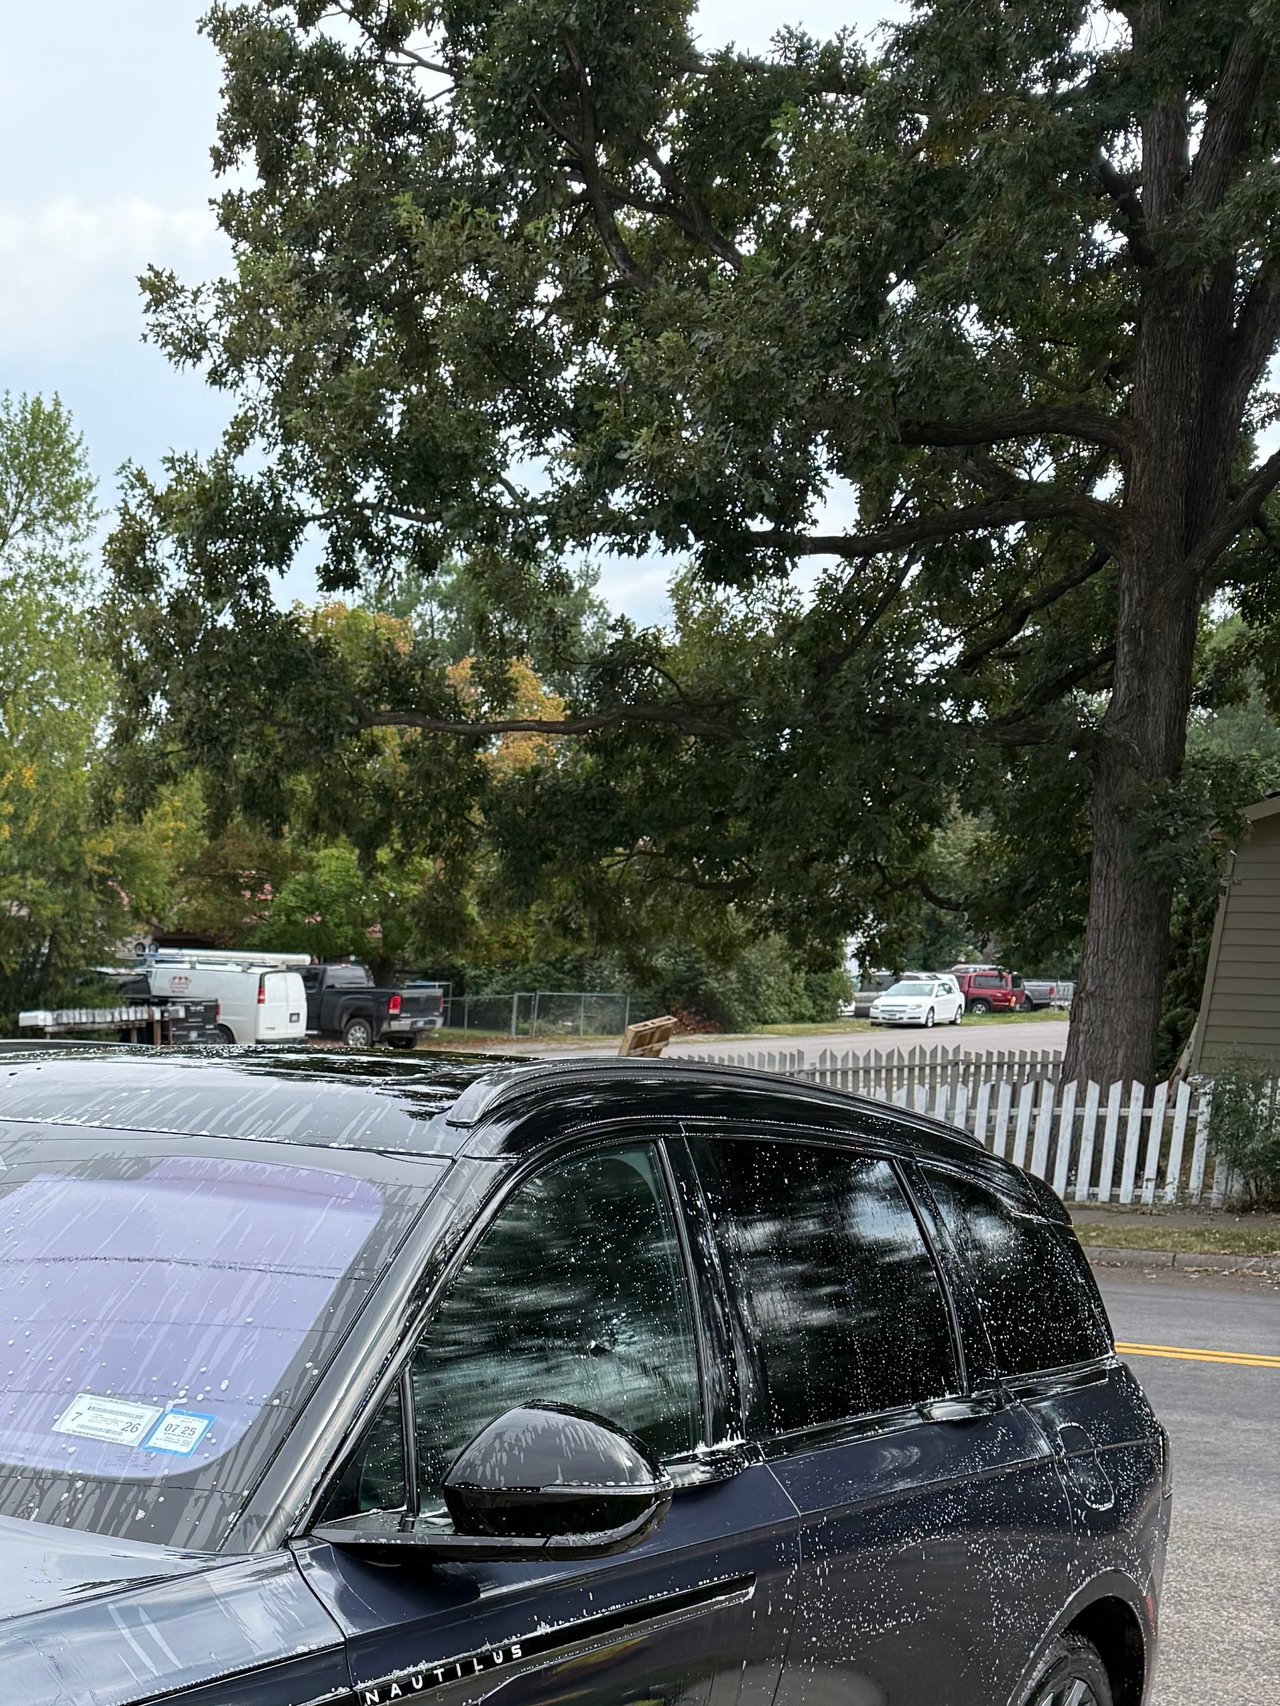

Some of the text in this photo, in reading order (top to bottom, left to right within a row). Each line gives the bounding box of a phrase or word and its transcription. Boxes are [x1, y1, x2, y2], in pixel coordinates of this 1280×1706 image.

[71, 1411, 84, 1422] 7
[121, 1421, 142, 1434] 26
[164, 1423, 198, 1437] 07 25
[365, 1644, 523, 1705] NAUTILUS
